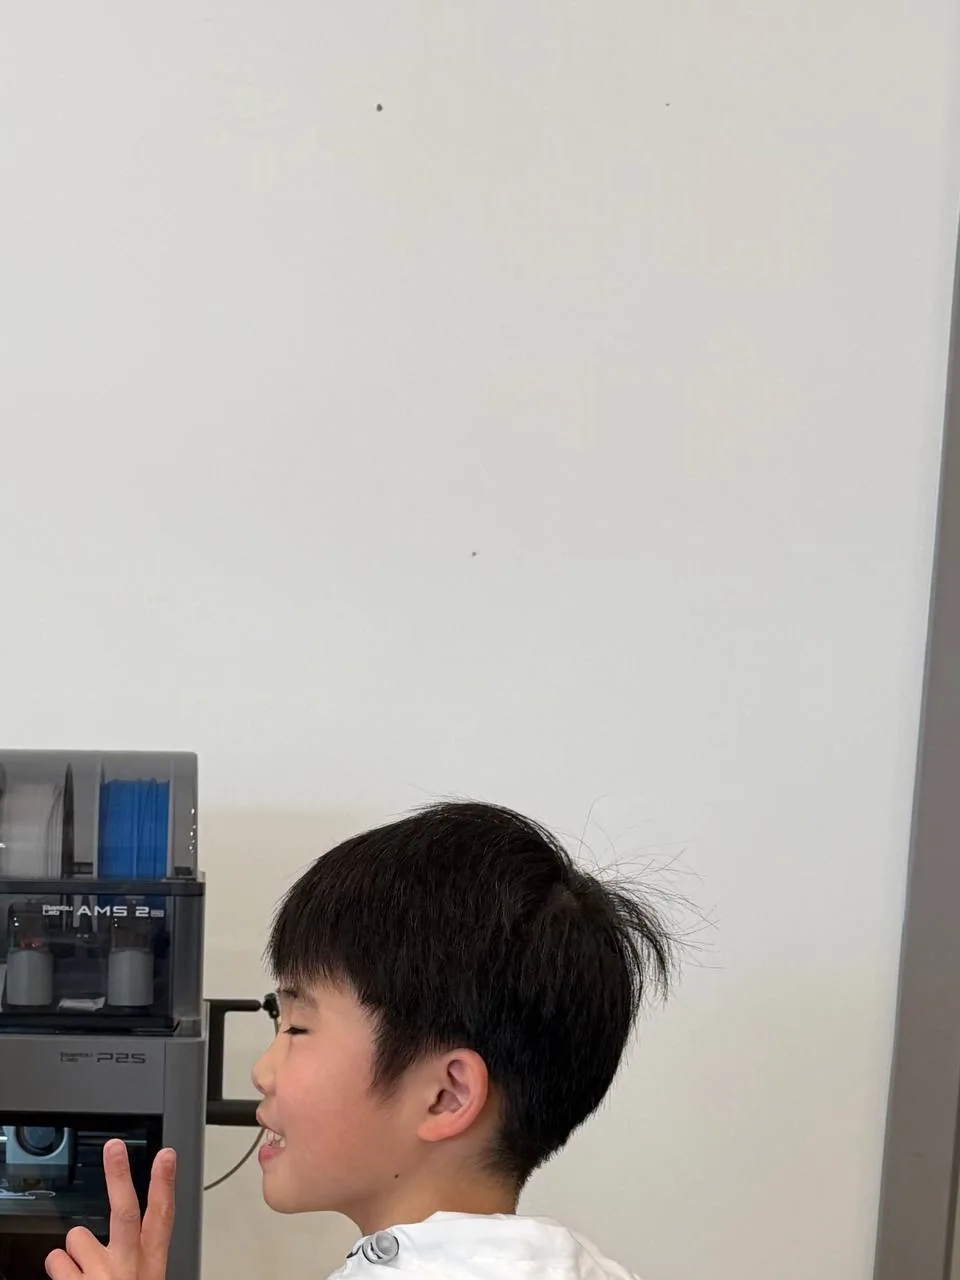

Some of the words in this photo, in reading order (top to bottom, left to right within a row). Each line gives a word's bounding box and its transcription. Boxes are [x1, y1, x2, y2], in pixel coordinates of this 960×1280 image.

[76, 905, 128, 917] AMS
[135, 906, 150, 917] 2
[96, 1052, 147, 1064] P2S
